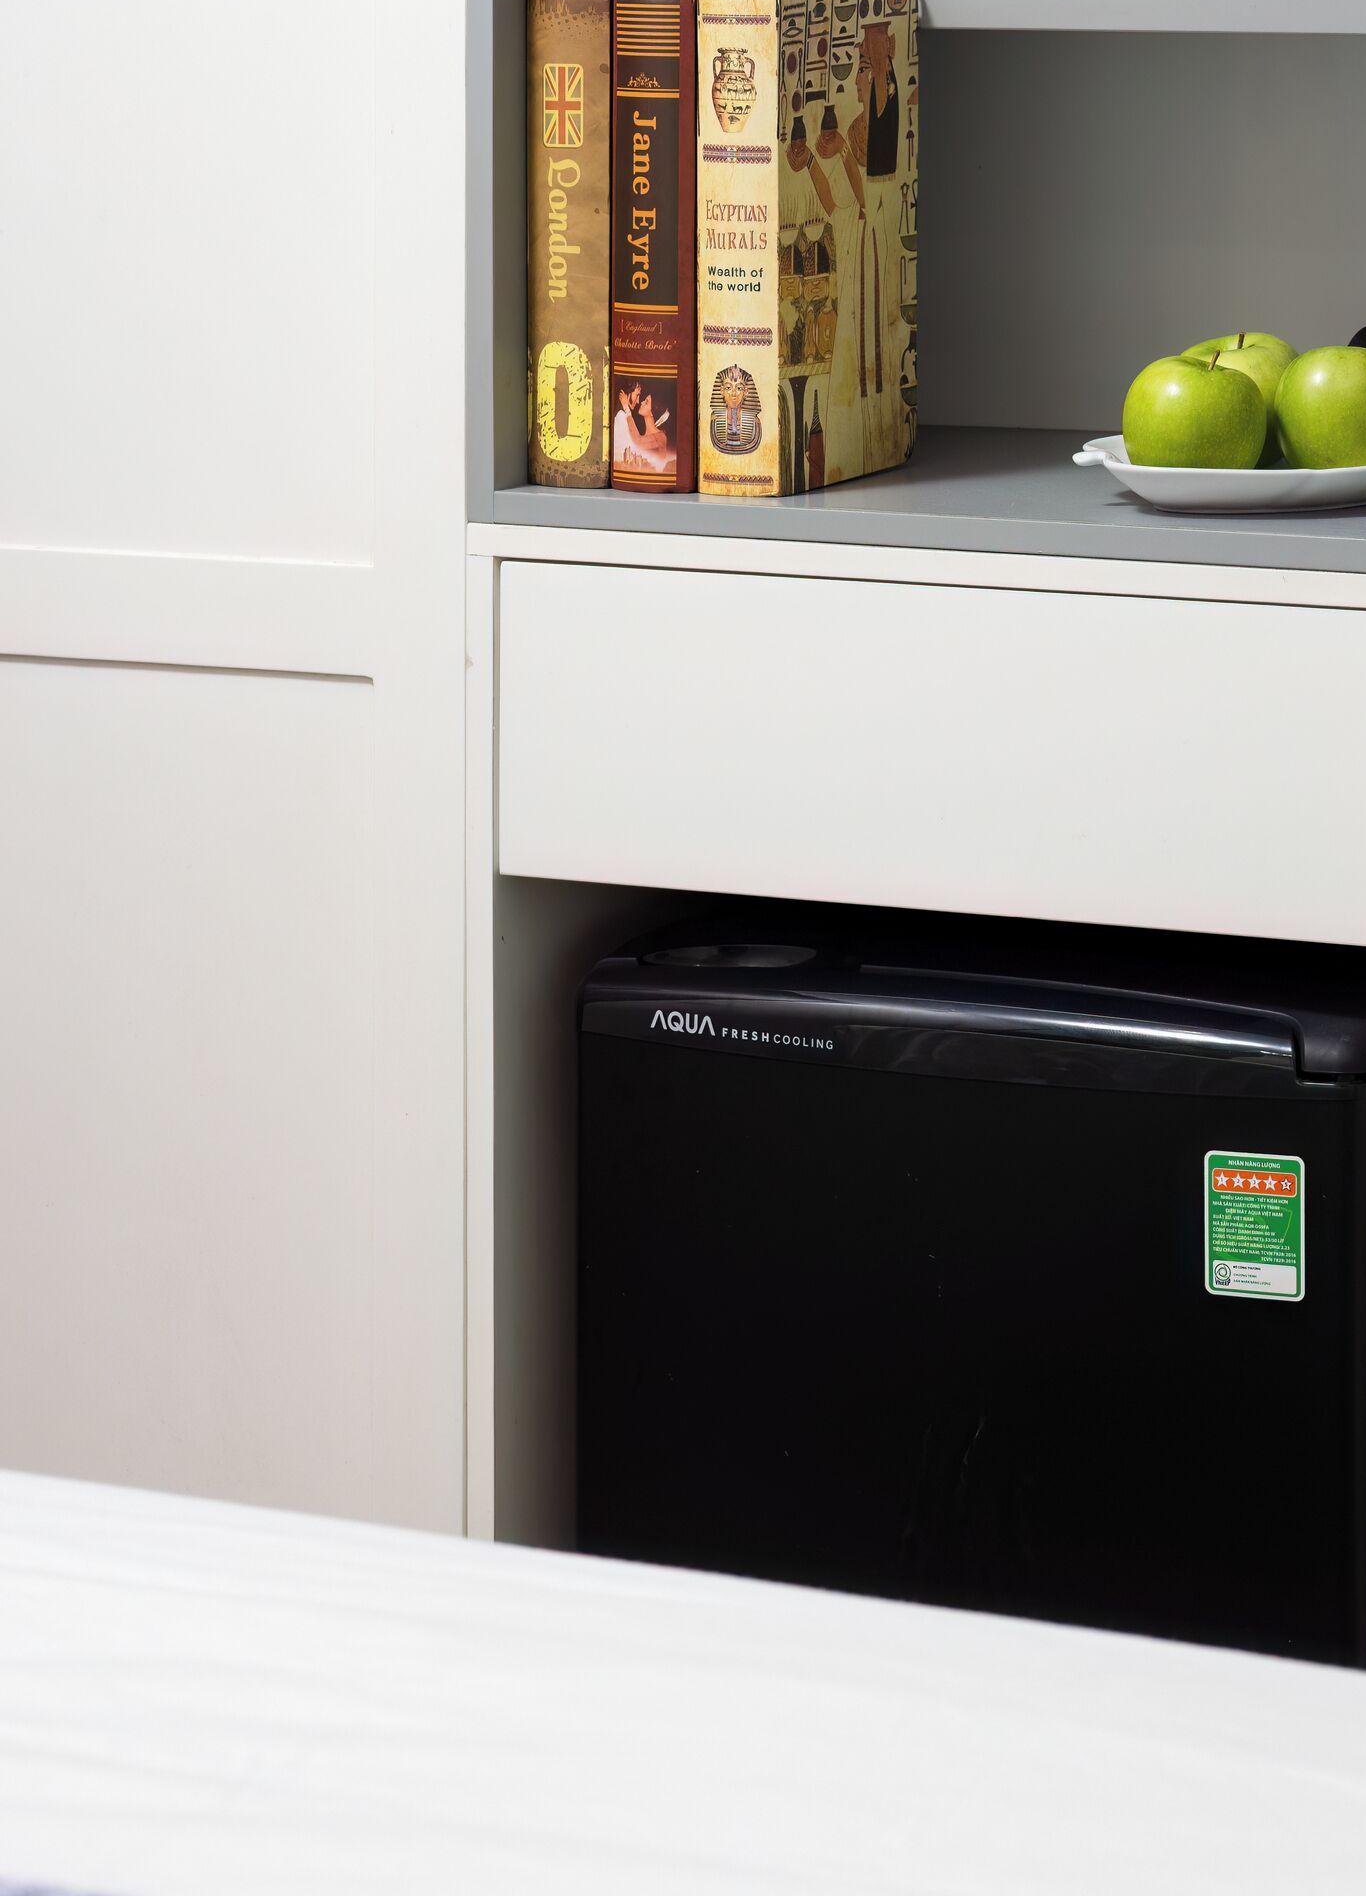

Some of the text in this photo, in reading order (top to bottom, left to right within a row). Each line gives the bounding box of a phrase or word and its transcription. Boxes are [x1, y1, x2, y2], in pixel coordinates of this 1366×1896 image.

[627, 111, 657, 291] Jane Eyre
[547, 158, 581, 304] London
[708, 266, 763, 278] Wealth of
[708, 281, 760, 292] the world
[651, 1009, 715, 1036] AQUA
